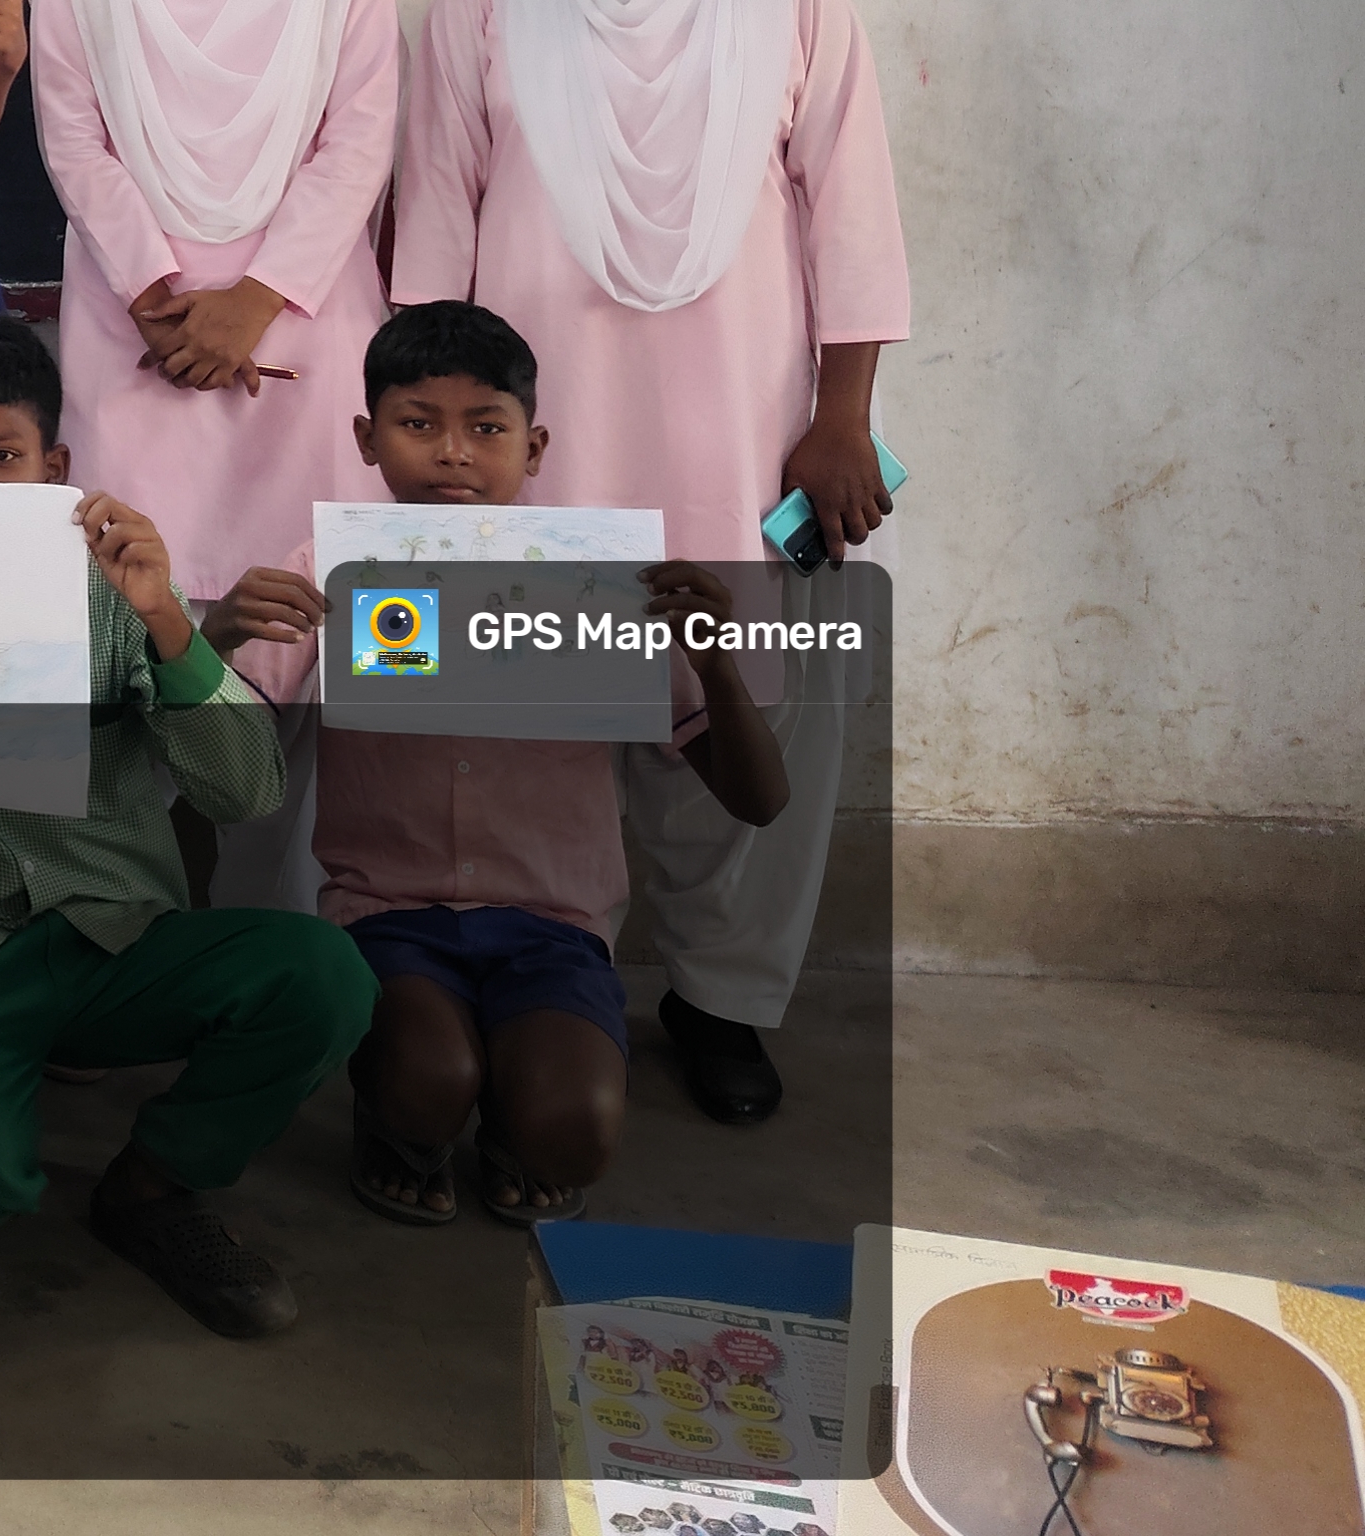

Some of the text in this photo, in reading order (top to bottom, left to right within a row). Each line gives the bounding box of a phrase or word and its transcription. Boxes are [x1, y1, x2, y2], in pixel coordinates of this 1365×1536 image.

[1050, 1284, 1187, 1314] Peacock
[590, 1372, 634, 1388] ₹2,500
[660, 1385, 704, 1404] ₹2,500
[596, 1414, 642, 1431] ₹5,000
[668, 1428, 714, 1445] ₹5,000
